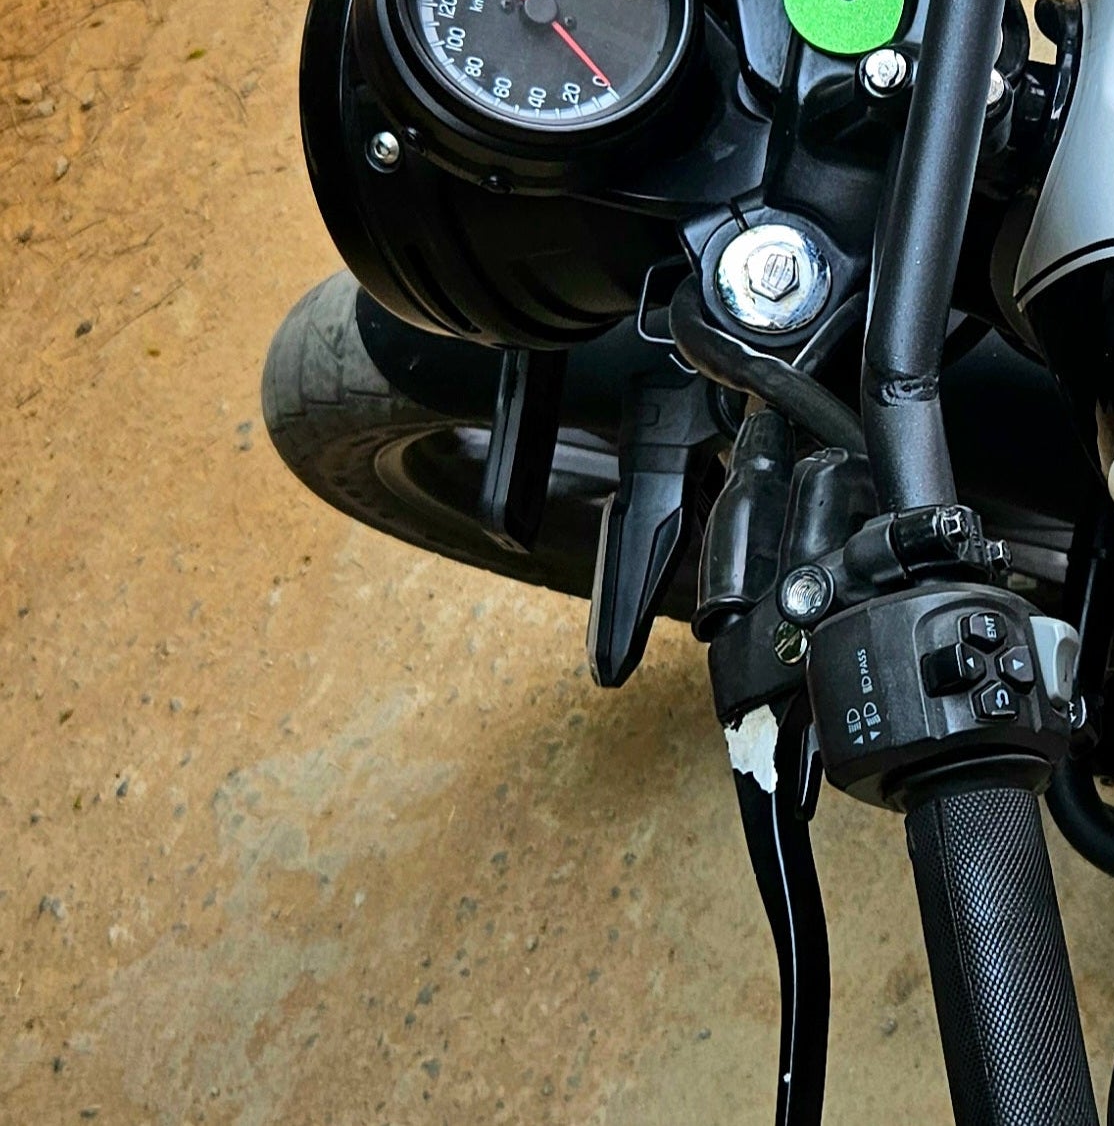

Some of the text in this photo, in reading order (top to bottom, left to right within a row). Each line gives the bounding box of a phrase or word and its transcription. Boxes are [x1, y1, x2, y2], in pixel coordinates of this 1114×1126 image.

[445, 27, 466, 51] 100
[464, 56, 484, 77] 80
[493, 77, 512, 98] 60
[592, 75, 611, 87] 0
[528, 86, 547, 108] 40
[562, 82, 581, 104] 20
[984, 615, 997, 638] ENT
[857, 649, 869, 674] PASS
